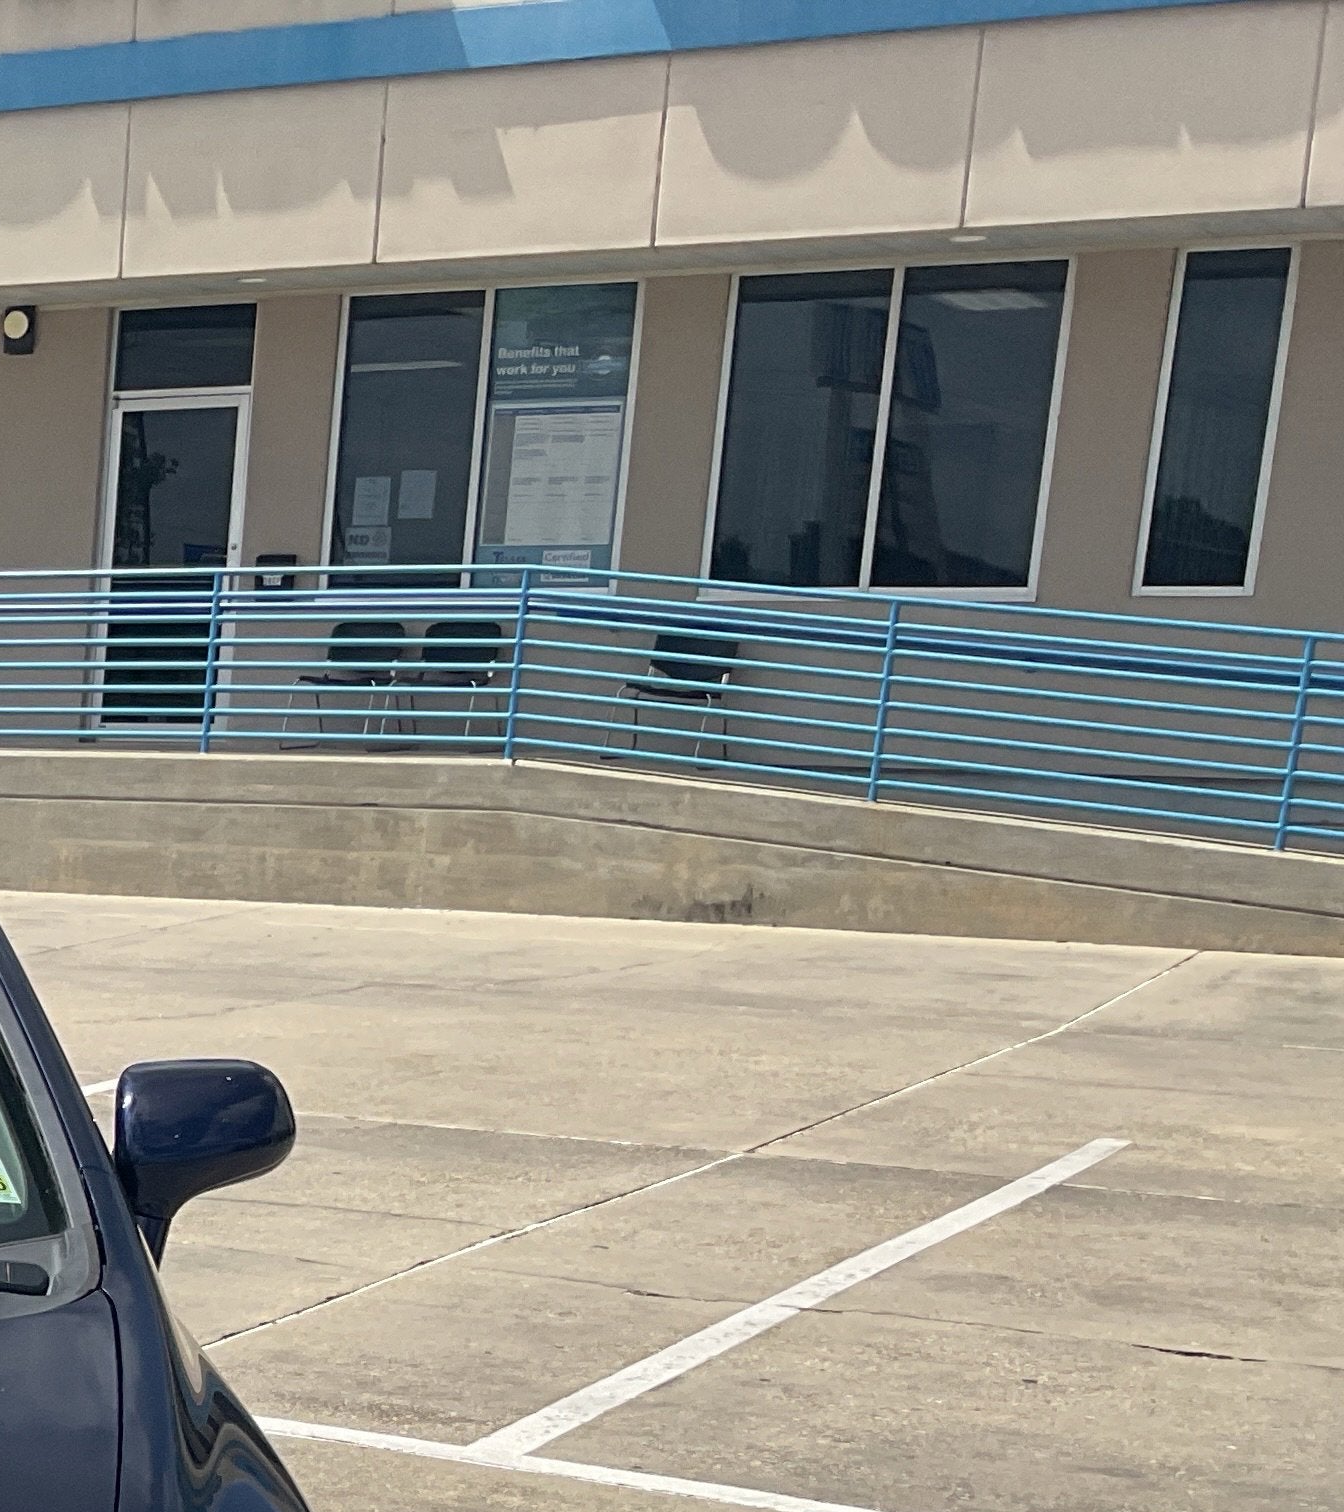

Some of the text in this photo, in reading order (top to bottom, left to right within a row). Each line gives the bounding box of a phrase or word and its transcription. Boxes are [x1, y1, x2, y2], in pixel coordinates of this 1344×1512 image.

[498, 345, 580, 359] Benefits that
[496, 363, 577, 377] work for you
